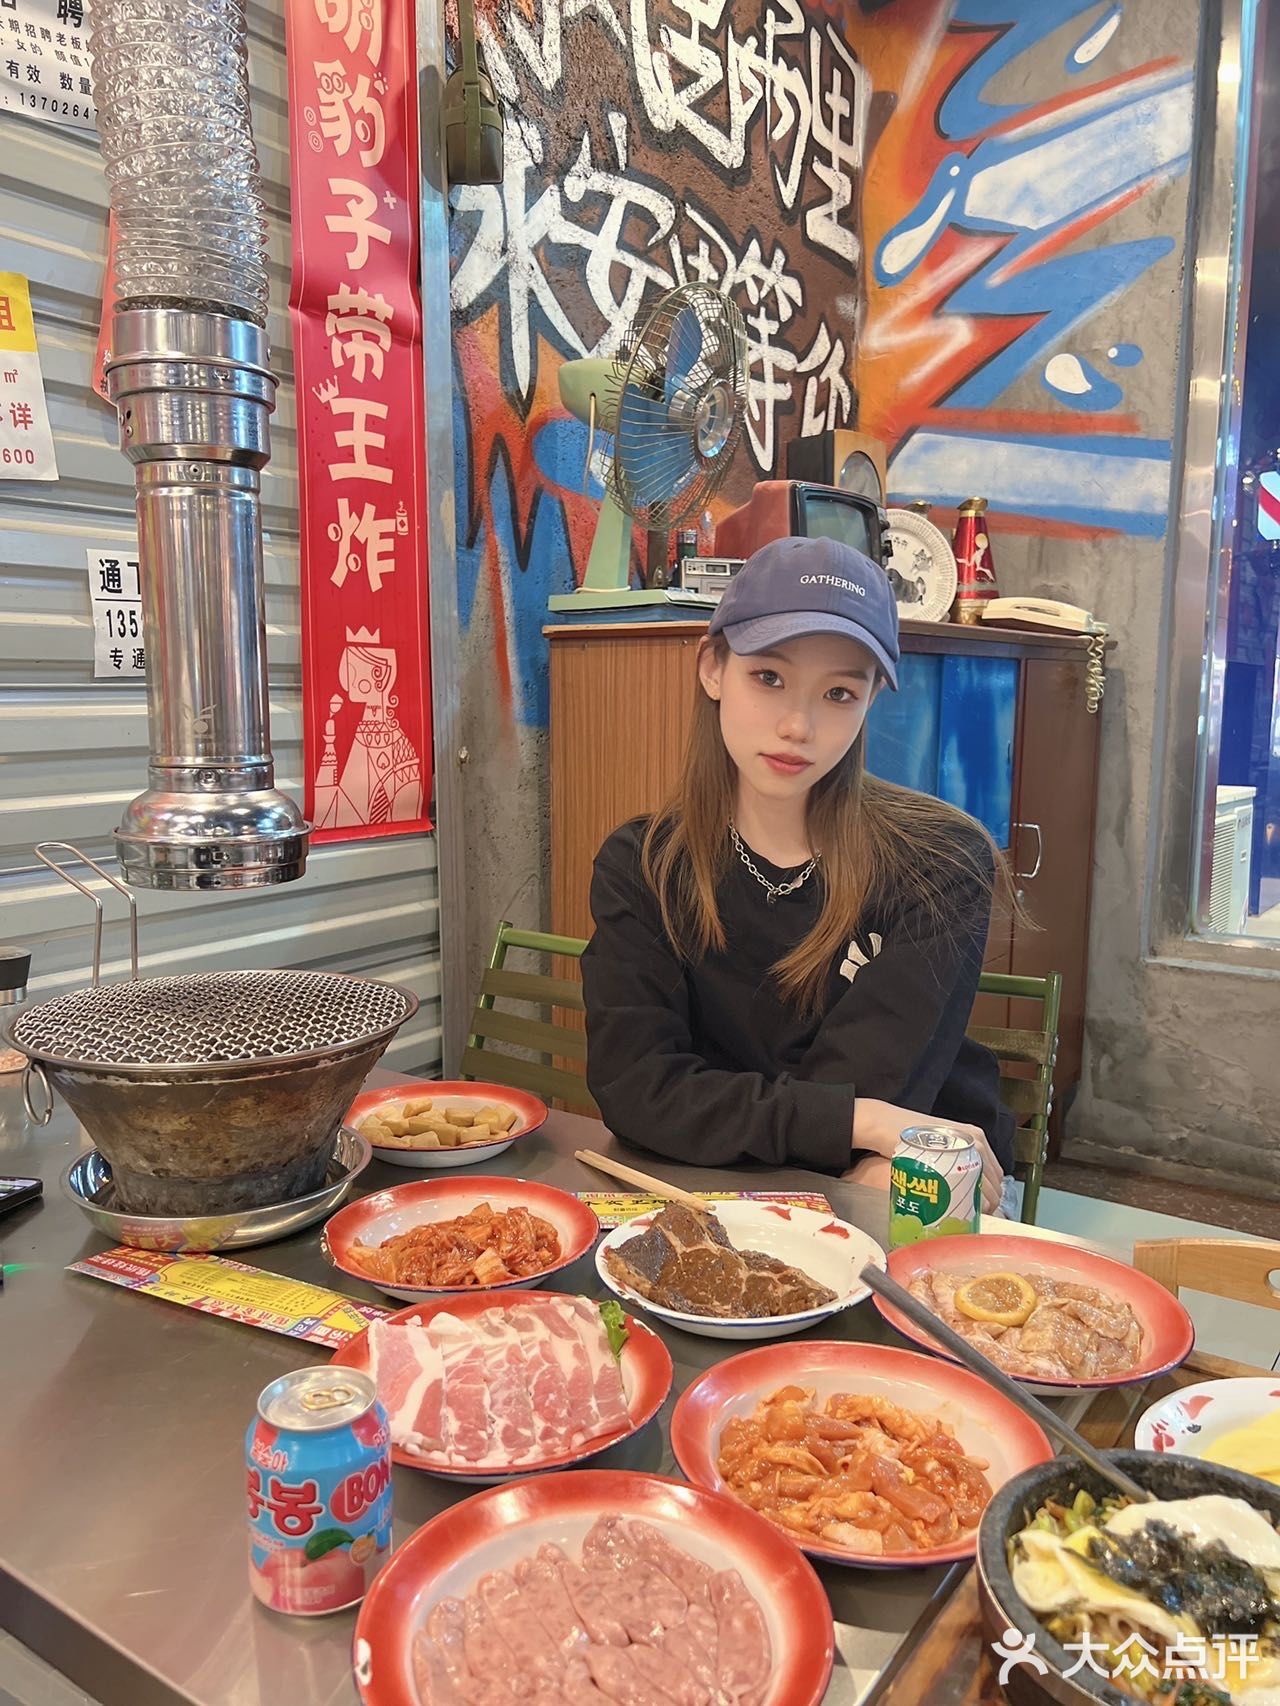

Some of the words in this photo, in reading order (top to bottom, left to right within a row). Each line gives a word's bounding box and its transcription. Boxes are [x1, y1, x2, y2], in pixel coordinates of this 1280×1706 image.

[0, 18, 90, 52] 期招聘老板
[55, 50, 90, 67] 颜值
[6, 60, 42, 84] 有效
[59, 72, 93, 96] 数量
[0, 402, 34, 431] 详
[800, 574, 866, 597] GATHERING
[106, 609, 144, 638] 135
